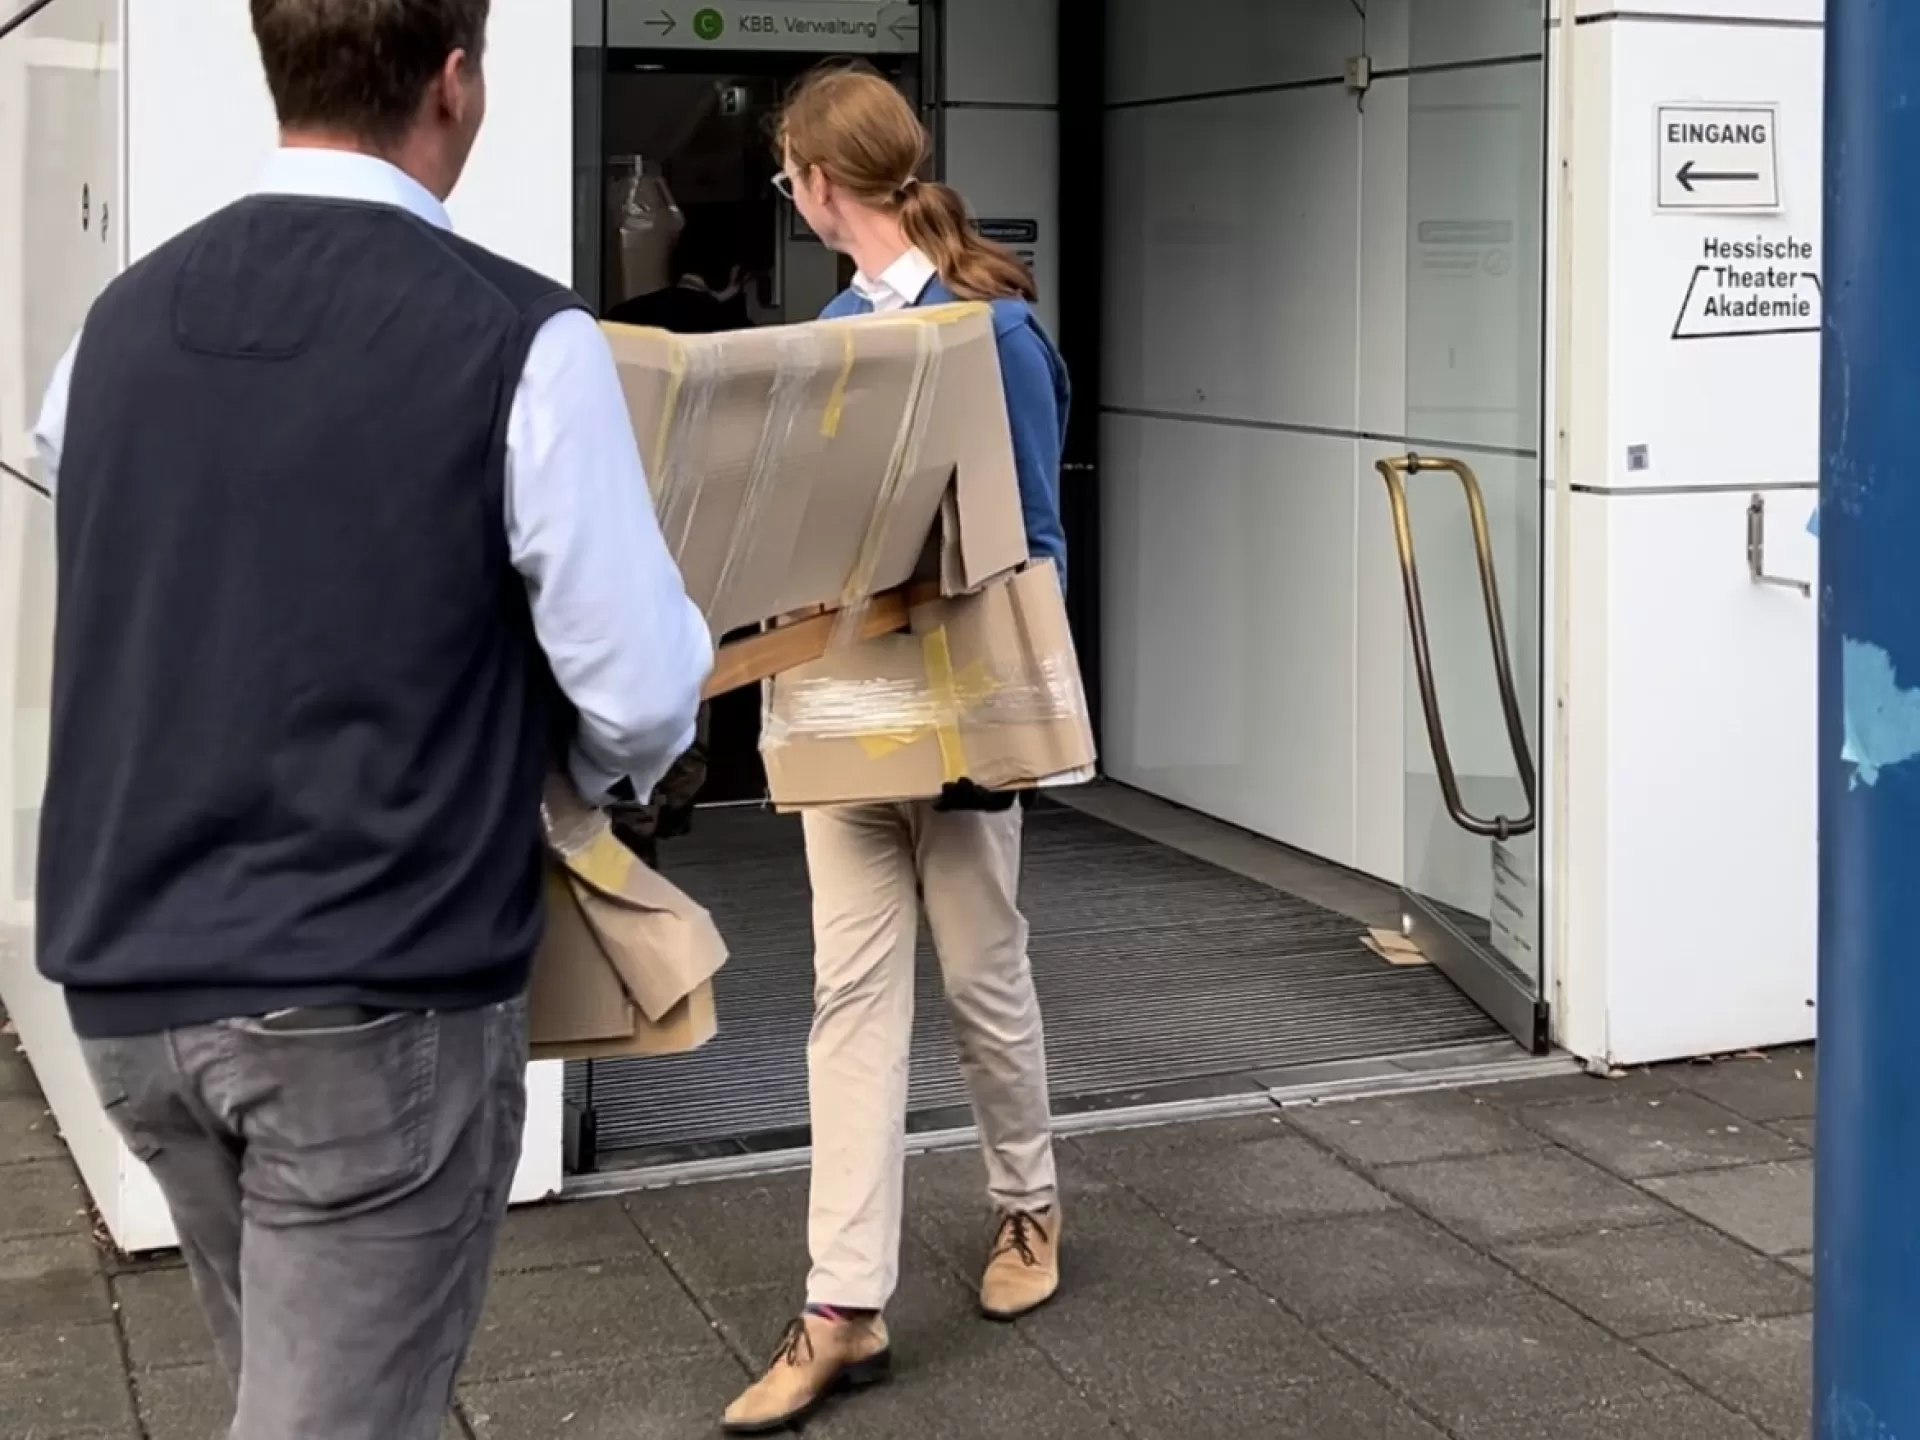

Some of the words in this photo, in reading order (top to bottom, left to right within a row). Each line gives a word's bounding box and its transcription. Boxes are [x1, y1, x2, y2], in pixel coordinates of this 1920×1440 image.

[701, 15, 715, 33] C
[738, 16, 779, 35] KBB,
[784, 16, 877, 38] Verwaltung
[1667, 123, 1767, 144] EINGANG
[1703, 234, 1813, 259] Hessische
[1713, 264, 1798, 288] Theater
[1703, 293, 1811, 317] Akademie
